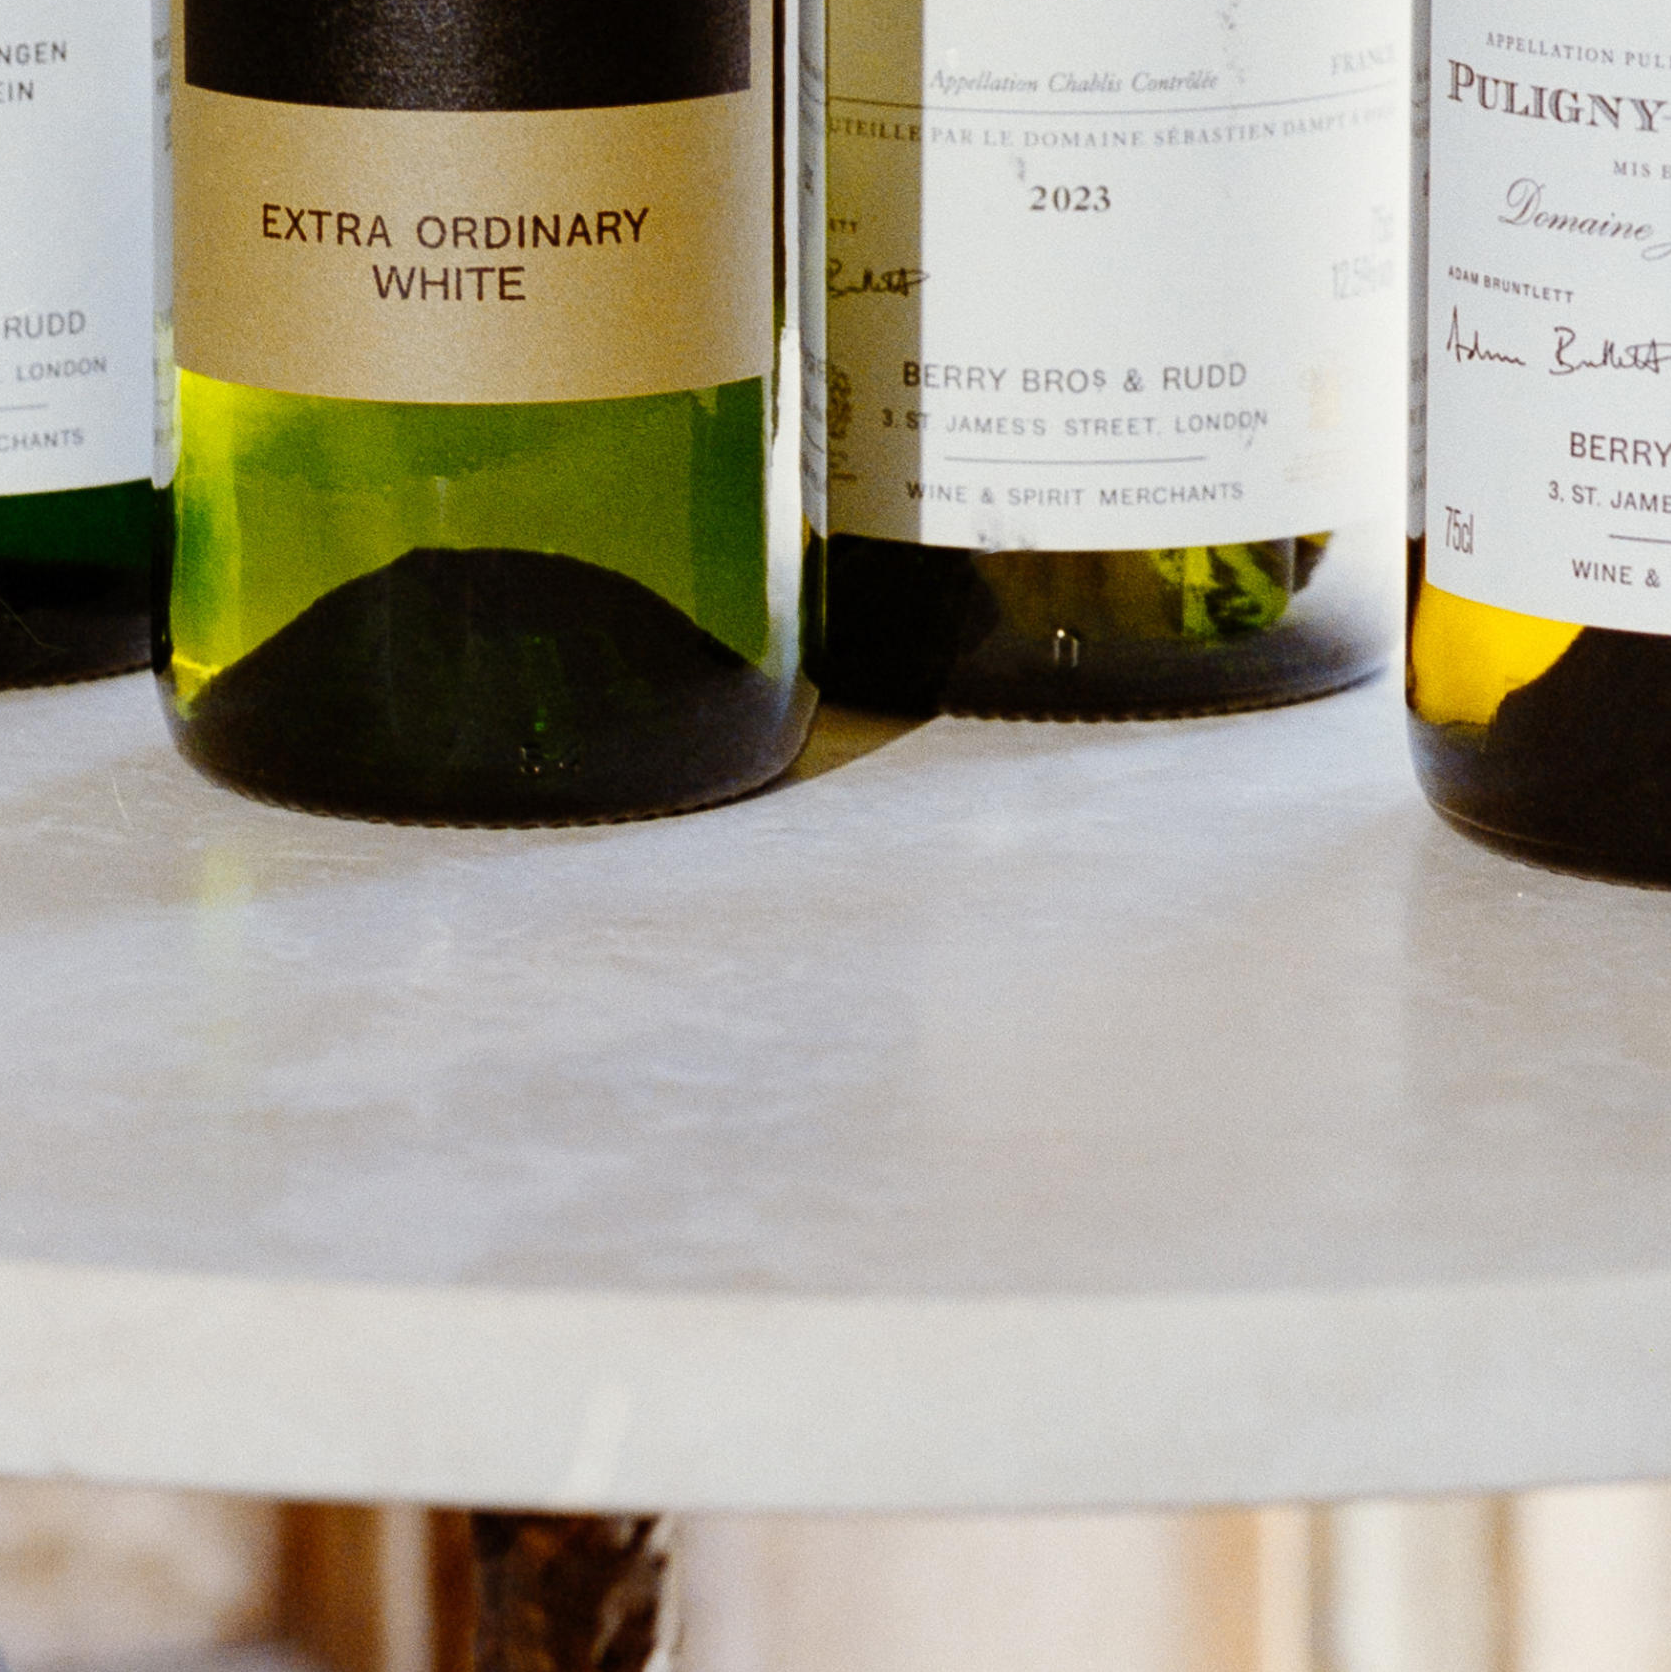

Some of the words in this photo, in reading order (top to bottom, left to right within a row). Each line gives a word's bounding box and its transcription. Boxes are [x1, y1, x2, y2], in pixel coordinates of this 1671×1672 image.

[1485, 30, 1616, 65] APPELLATION
[928, 68, 1040, 97] Appellation
[1047, 71, 1123, 94] Chablis
[827, 117, 922, 144] UTEILLE
[931, 127, 973, 146] PAR
[982, 128, 1014, 148] LE
[1023, 130, 1143, 149] DOMAINE
[1153, 122, 1276, 148] SÉBASTIEN
[1612, 159, 1652, 179] MIS
[1029, 184, 1112, 213] 2023
[1497, 177, 1654, 241] Domaine
[261, 202, 393, 249] EXTRA
[415, 206, 650, 251] ORDINARY
[371, 263, 527, 302] WHITE
[1447, 265, 1480, 286] ADAM
[1482, 274, 1575, 304] BRUNTLETT
[2, 309, 87, 341] RUDD
[15, 355, 108, 383] LONDON
[902, 360, 1008, 392] BERRY
[1122, 367, 1145, 394] &
[1161, 360, 1248, 392] RUDD
[945, 415, 1047, 437] JAMES'S
[1173, 408, 1269, 435] LONDON
[905, 480, 967, 504] WINE
[979, 486, 996, 506] &
[1006, 486, 1086, 507] SPIRIT
[1098, 480, 1245, 507] MERCHANTS
[1444, 504, 1475, 556] 75cl
[1570, 558, 1633, 587] WINE
[1643, 567, 1662, 589] &
